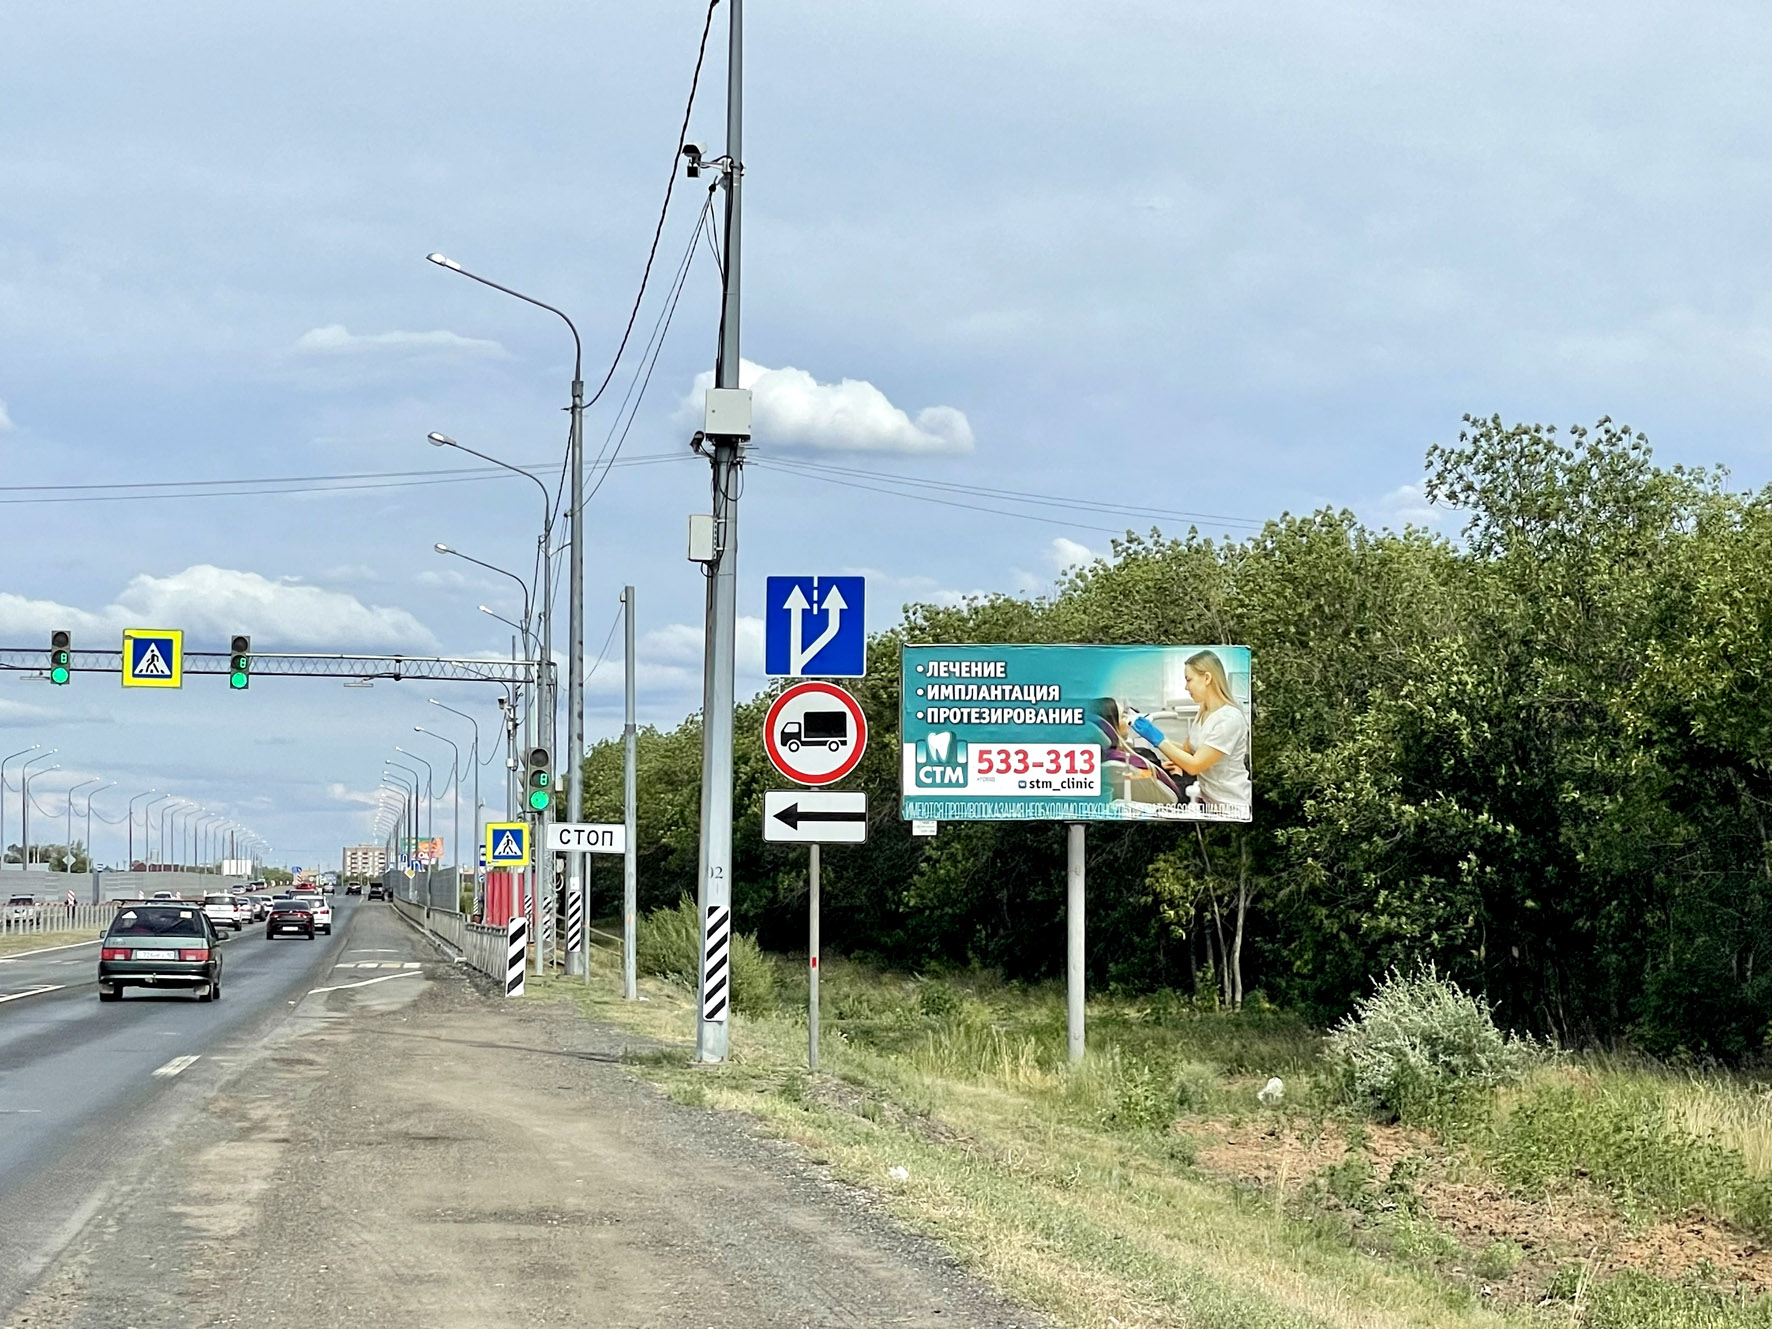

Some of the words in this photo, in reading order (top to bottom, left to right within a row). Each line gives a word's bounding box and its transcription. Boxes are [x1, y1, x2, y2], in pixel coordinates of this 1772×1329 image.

[925, 661, 1006, 678] ЛЕЧЕНИЕ
[926, 684, 1060, 704] ИМПЛАНТАЦИЯ
[926, 707, 1083, 725] ПРОТЕЗИРОВАНИЕ
[977, 748, 1095, 775] 533-313
[918, 766, 964, 784] СТМ
[1029, 777, 1095, 791] stm_clinic
[559, 829, 613, 847] СТОП
